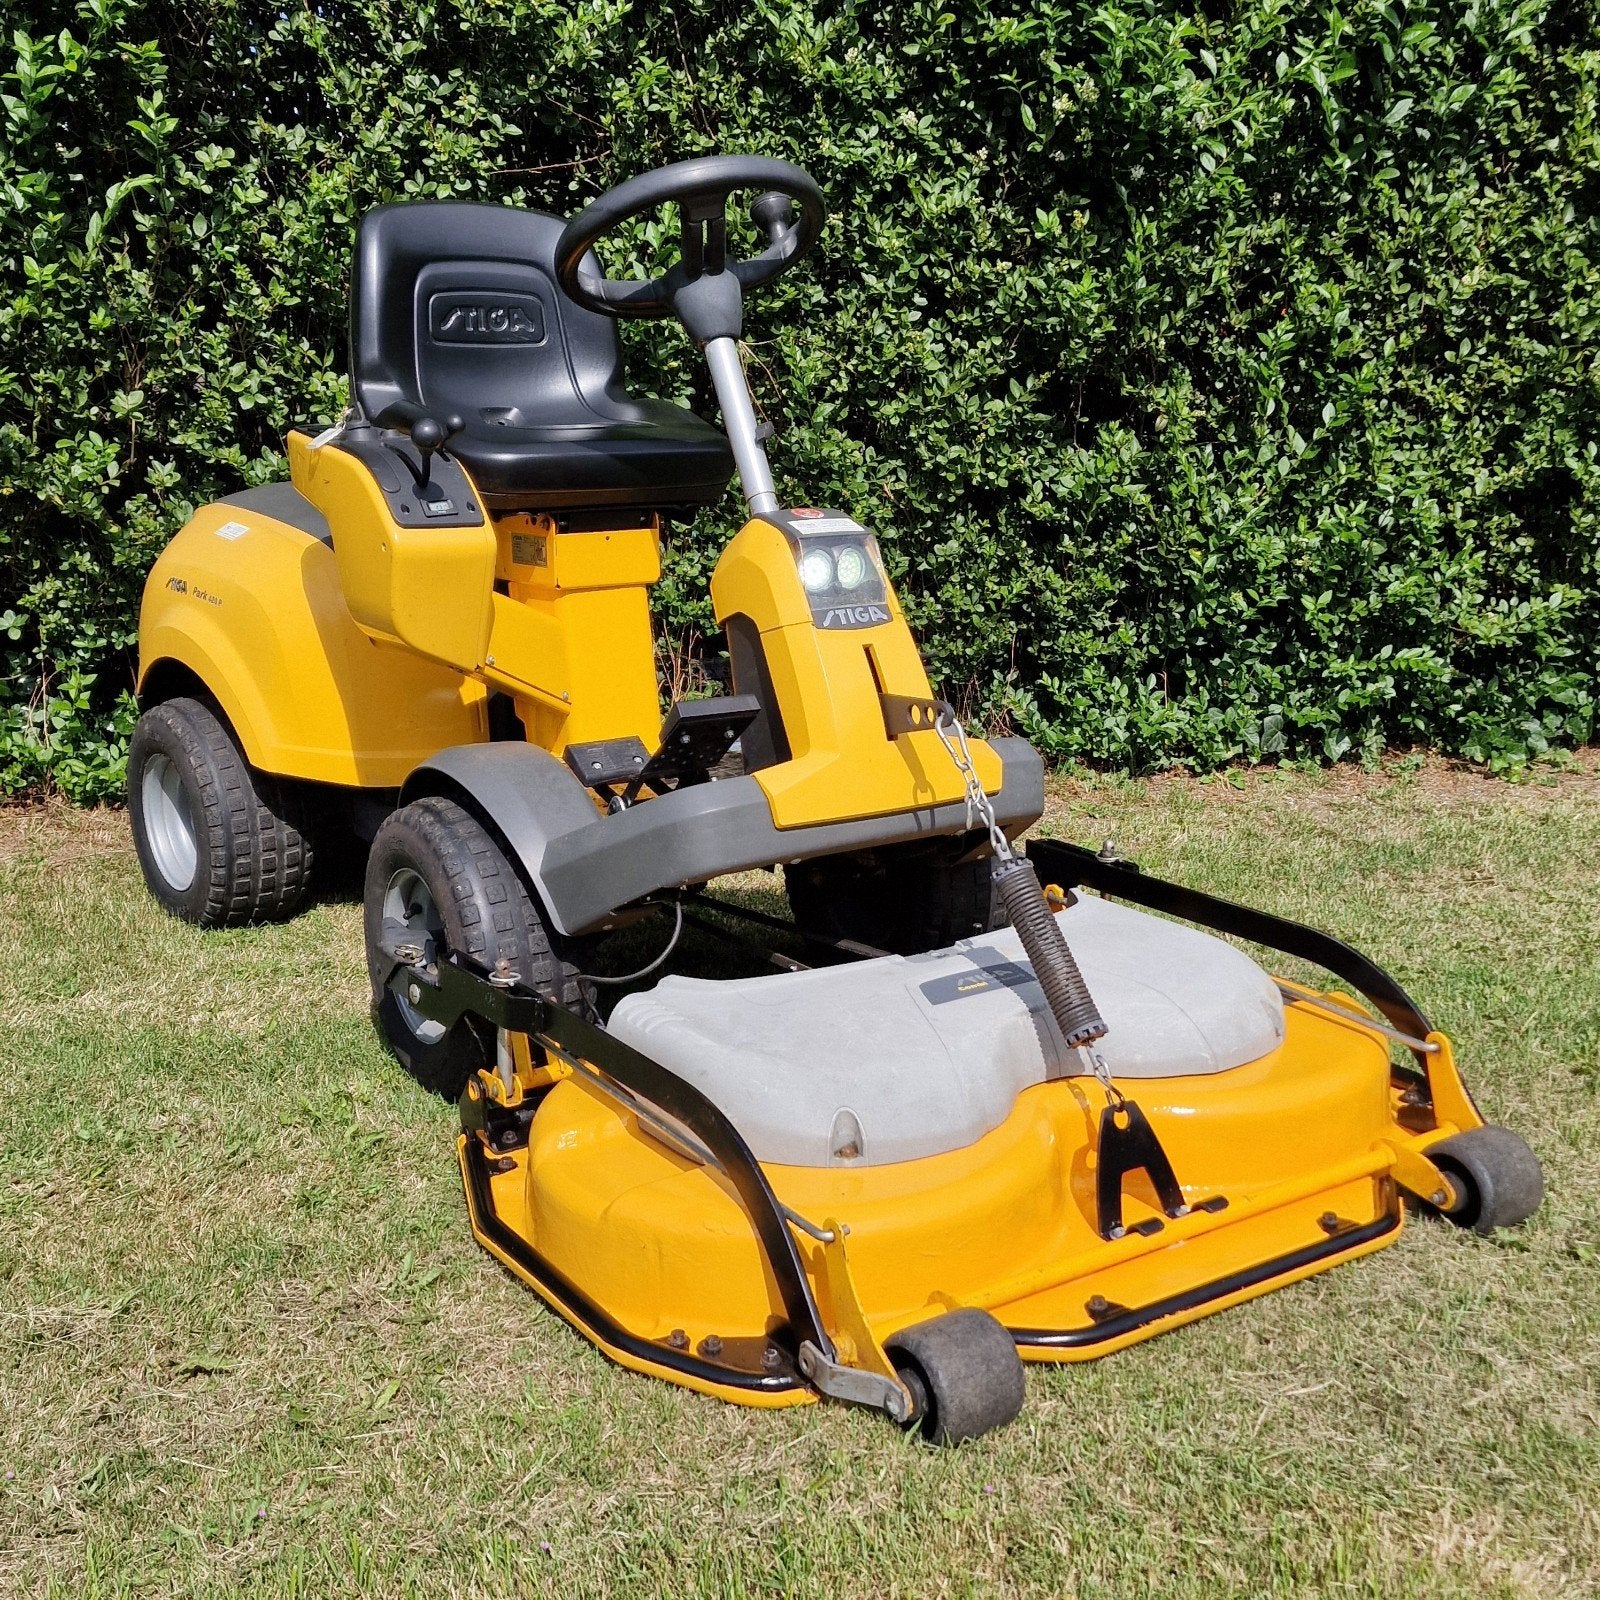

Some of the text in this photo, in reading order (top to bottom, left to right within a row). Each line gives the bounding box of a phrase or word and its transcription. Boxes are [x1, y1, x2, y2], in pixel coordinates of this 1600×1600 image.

[440, 307, 535, 332] STIGA
[192, 586, 208, 600] Park
[822, 606, 888, 627] STIGA
